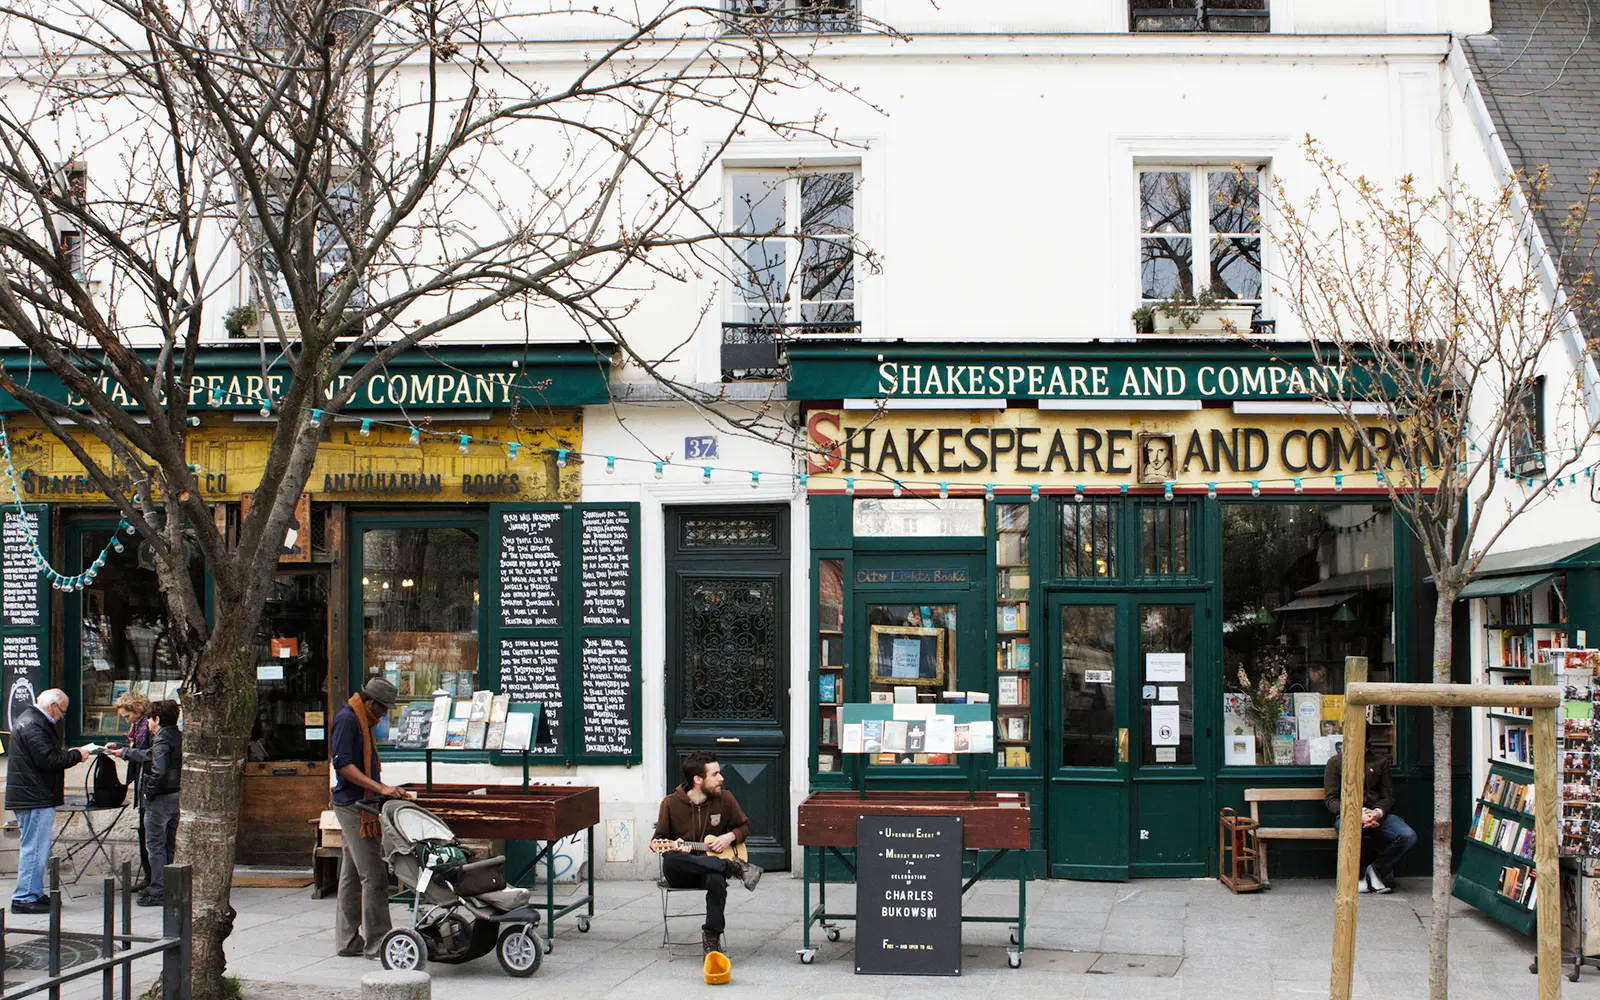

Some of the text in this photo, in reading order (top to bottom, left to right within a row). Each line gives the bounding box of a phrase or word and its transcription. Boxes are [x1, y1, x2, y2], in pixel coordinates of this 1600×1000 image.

[878, 362, 1348, 396] SHAKESPEARE AND COMPANY
[367, 373, 517, 405] COMPANY
[690, 439, 714, 457] 37
[807, 412, 1133, 476] SHAKESPEARE
[1183, 428, 1269, 473] AND
[323, 473, 520, 494] ANTIQUARIAN BOOKS
[933, 569, 966, 583] Books
[885, 890, 934, 901] CHARLES
[881, 906, 937, 919] BUKOWSKI
